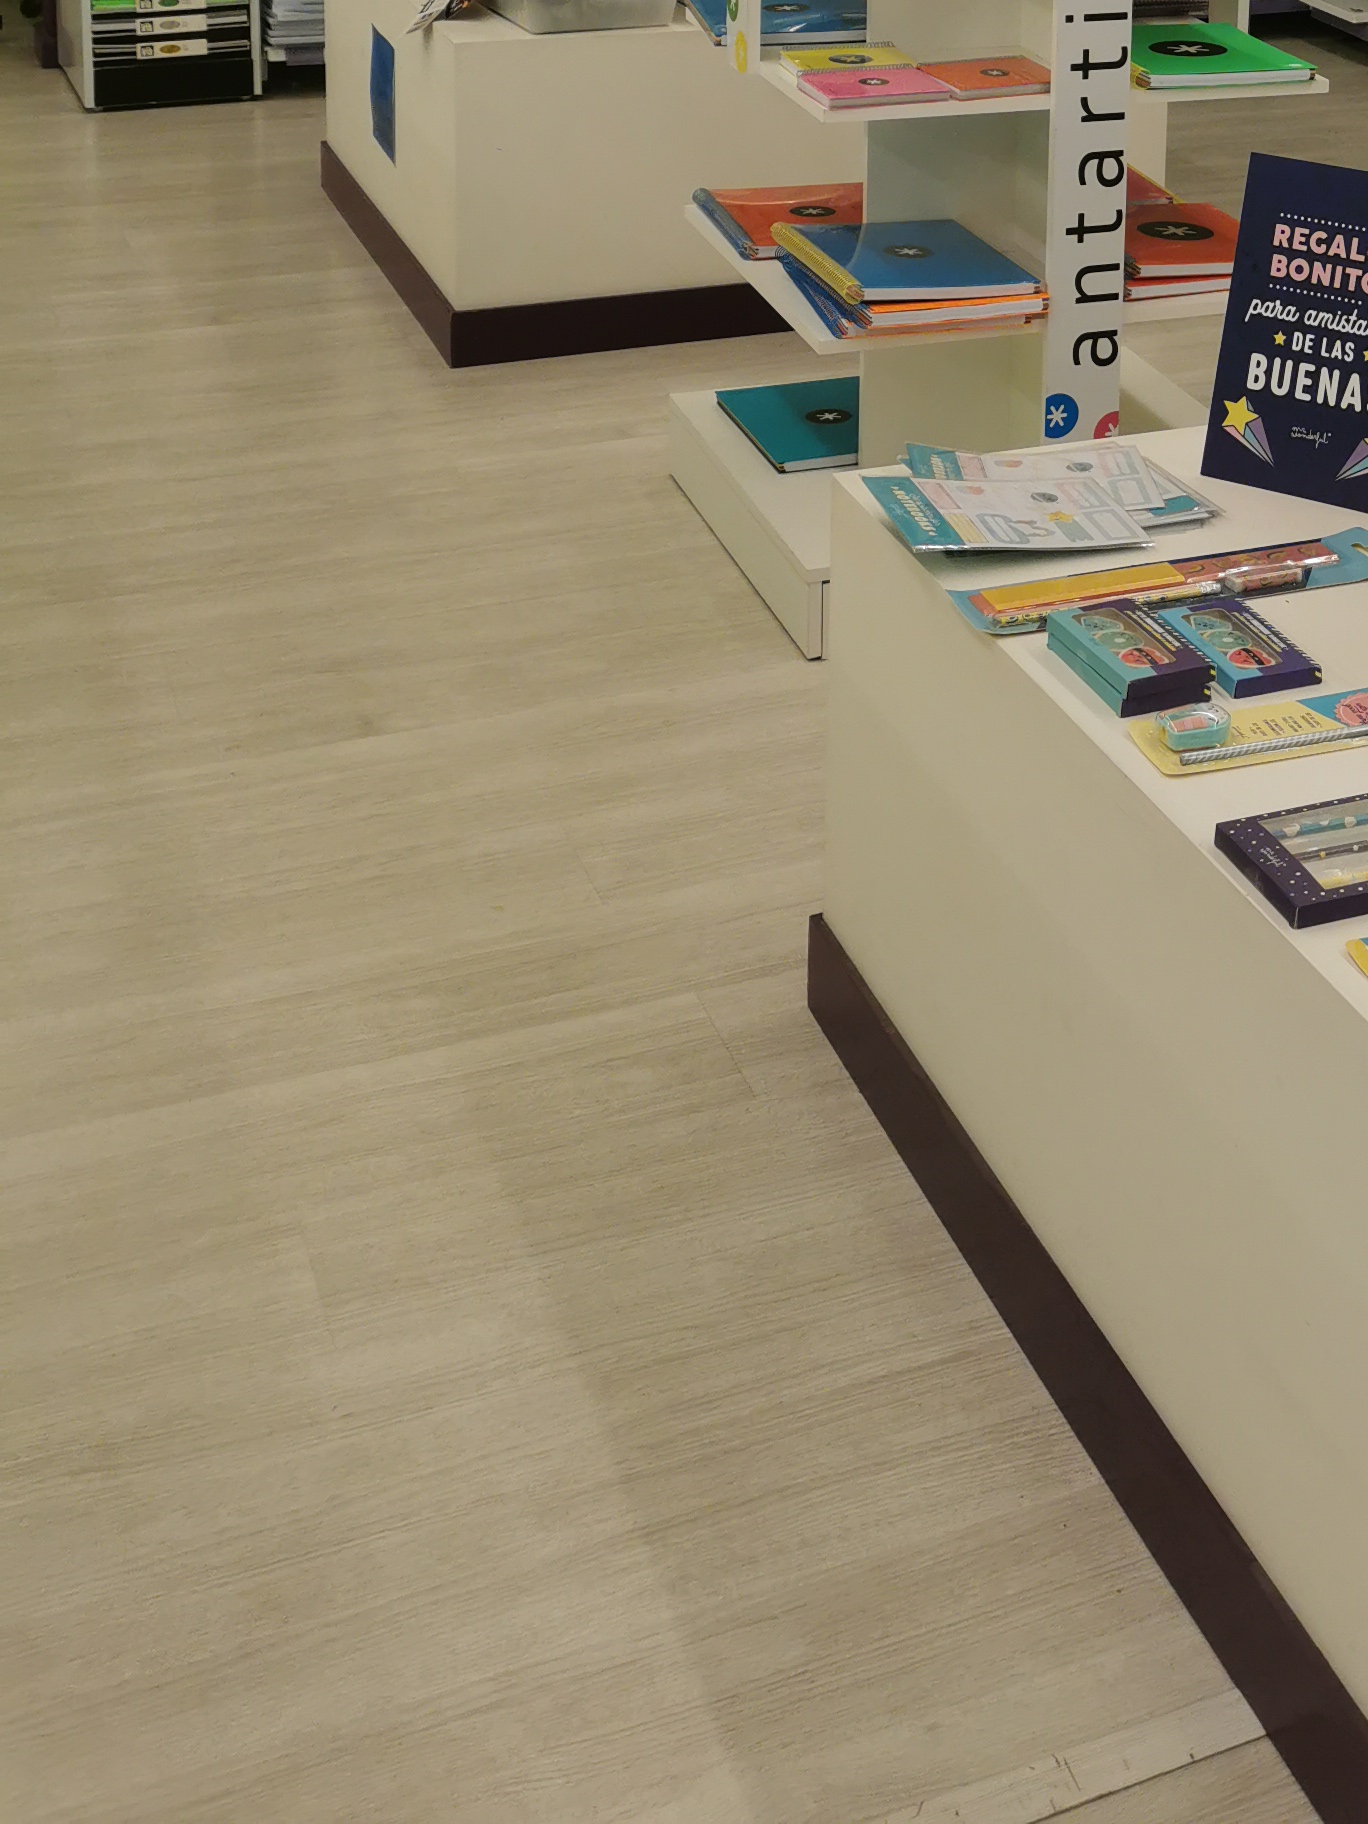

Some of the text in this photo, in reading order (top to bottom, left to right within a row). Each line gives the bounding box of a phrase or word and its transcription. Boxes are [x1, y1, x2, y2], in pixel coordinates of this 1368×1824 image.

[1244, 298, 1300, 323] para
[1291, 331, 1356, 362] DE LAS
